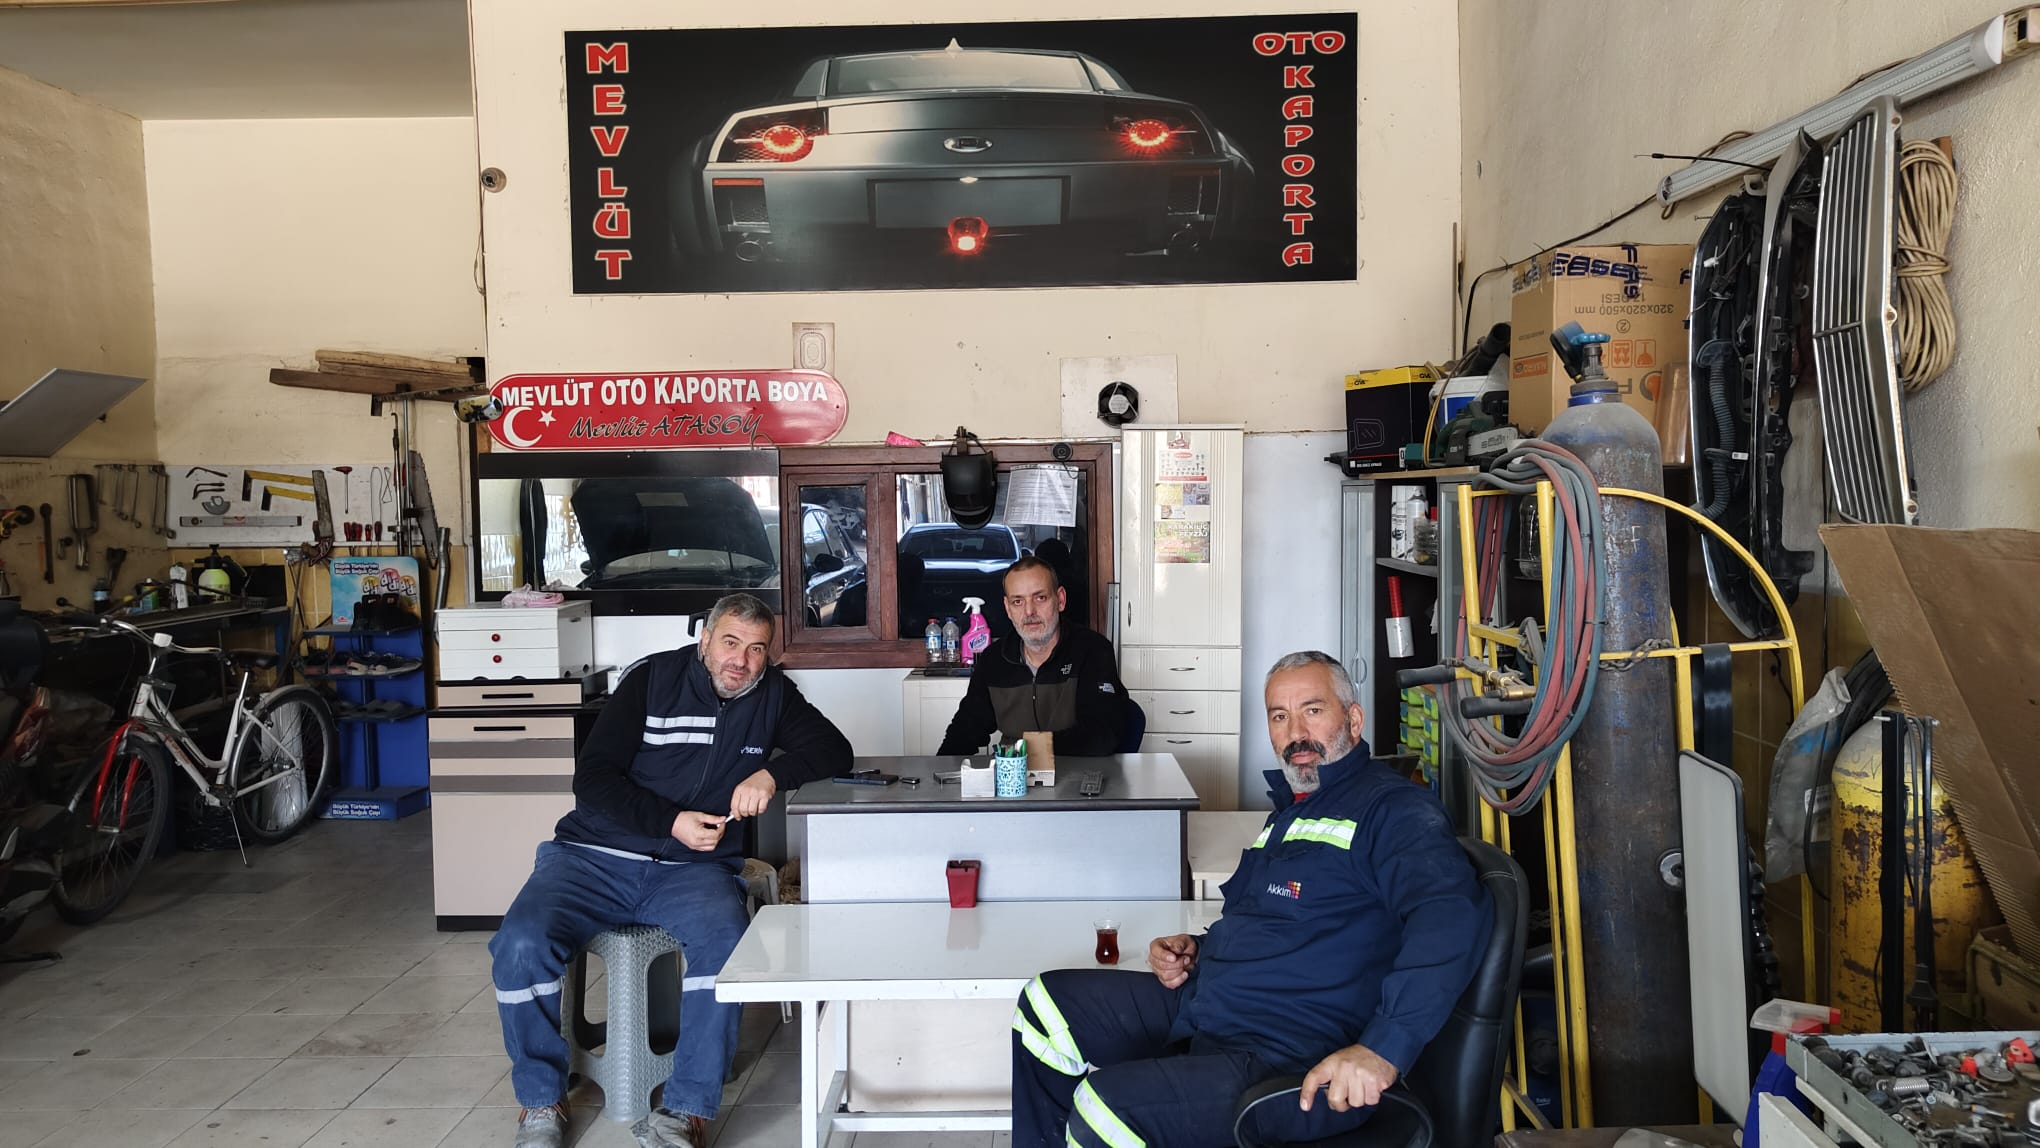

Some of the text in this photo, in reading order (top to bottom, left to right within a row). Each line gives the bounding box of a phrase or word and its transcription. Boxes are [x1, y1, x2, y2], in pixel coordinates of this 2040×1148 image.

[1252, 30, 1346, 56] OTO
[585, 42, 632, 281] MEVLÜT
[1281, 65, 1316, 268] KAPORTA
[1575, 304, 1674, 315] 320x320x500 mm
[502, 376, 828, 407] MEVLÜT OTO KAPORTA BOYA
[568, 413, 763, 440] Mevlüt ATASOY
[1267, 883, 1292, 897] Akkim
